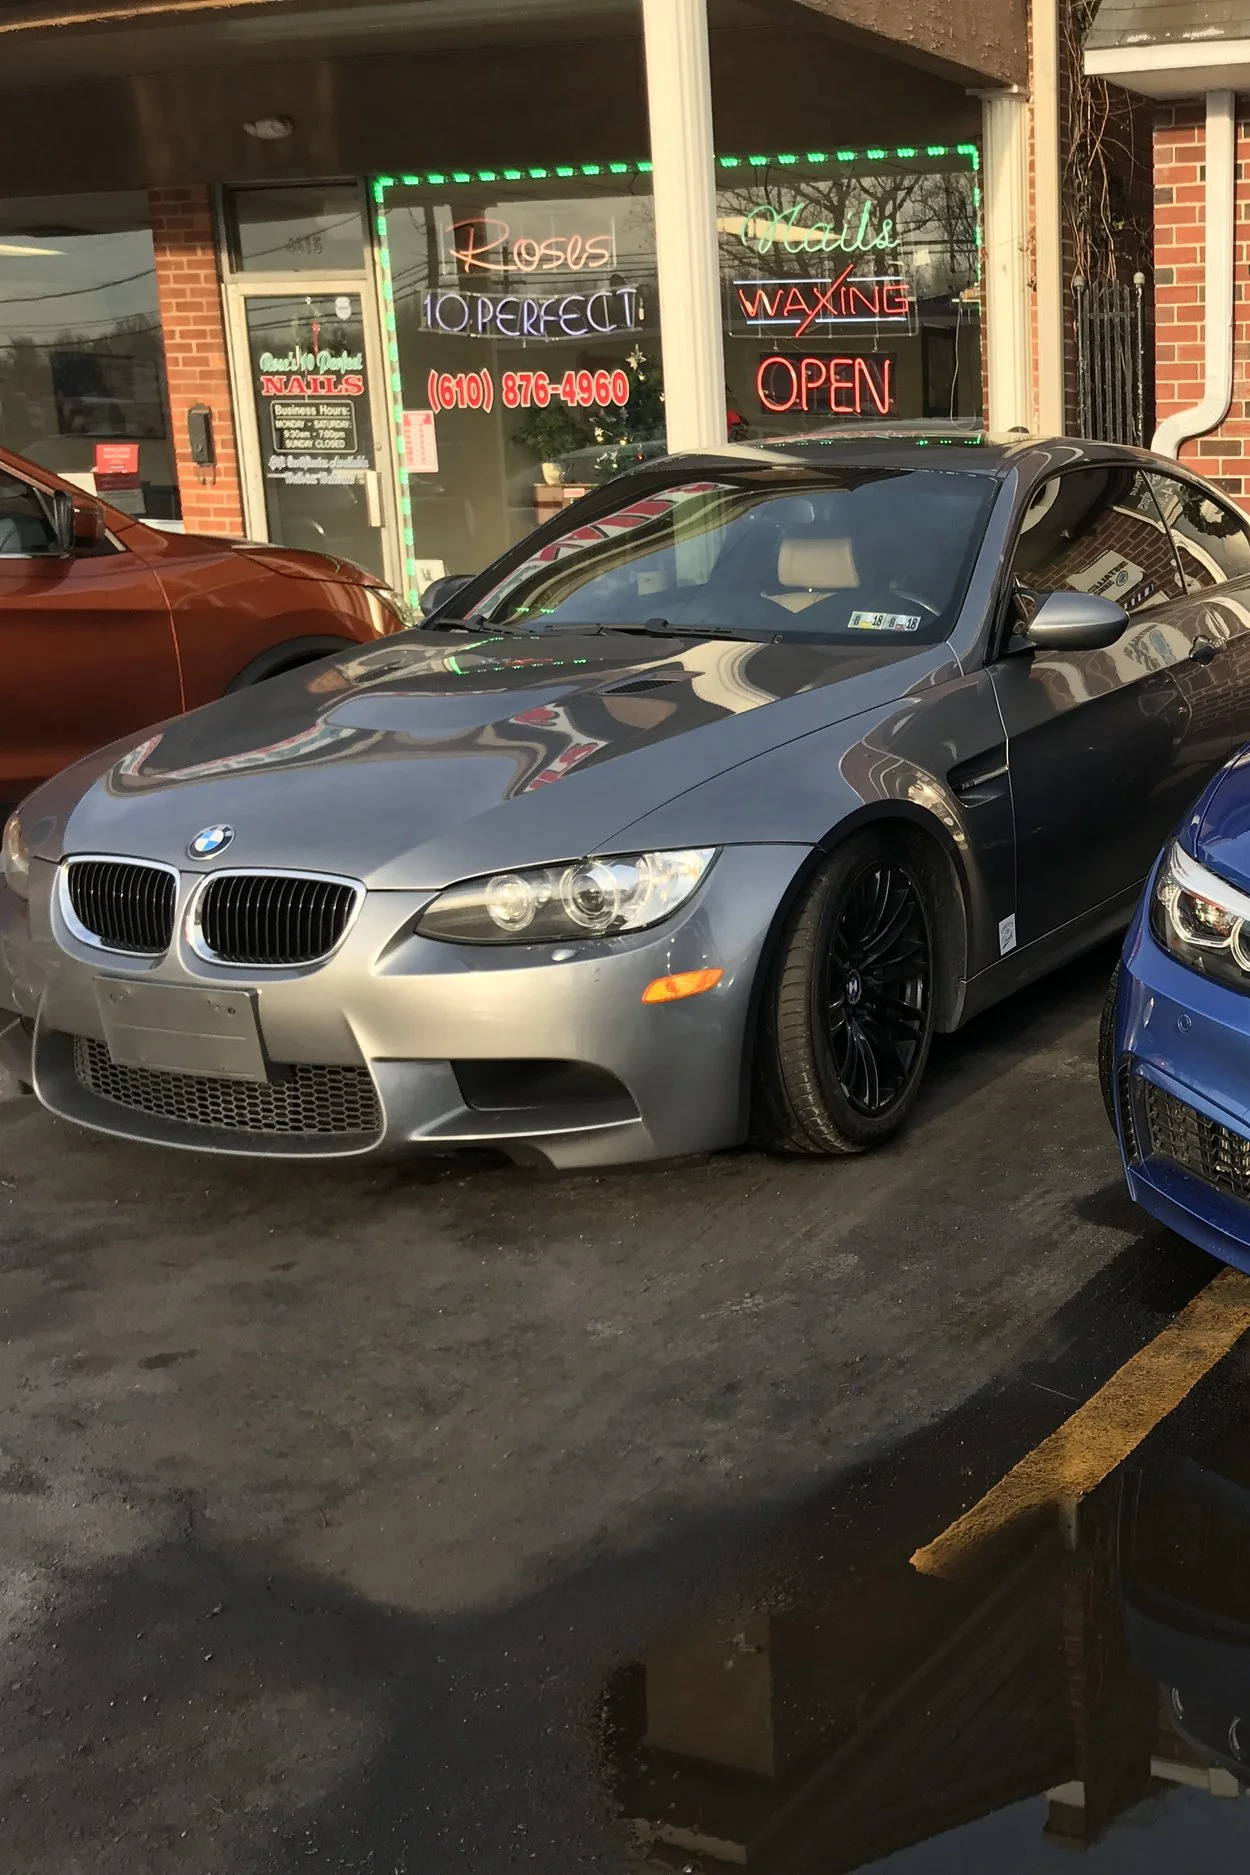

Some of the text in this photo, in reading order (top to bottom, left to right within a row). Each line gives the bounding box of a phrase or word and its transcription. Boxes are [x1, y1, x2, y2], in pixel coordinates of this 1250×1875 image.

[445, 218, 613, 272] Roses
[741, 200, 901, 254] Nails
[423, 288, 637, 336] 10 PERFECT
[260, 375, 364, 396] NAILS
[428, 369, 630, 414] (610) 876-4960
[756, 356, 891, 415] OPEN
[274, 405, 350, 416] Business Hours:
[872, 615, 884, 627] 18
[906, 618, 918, 630] 18
